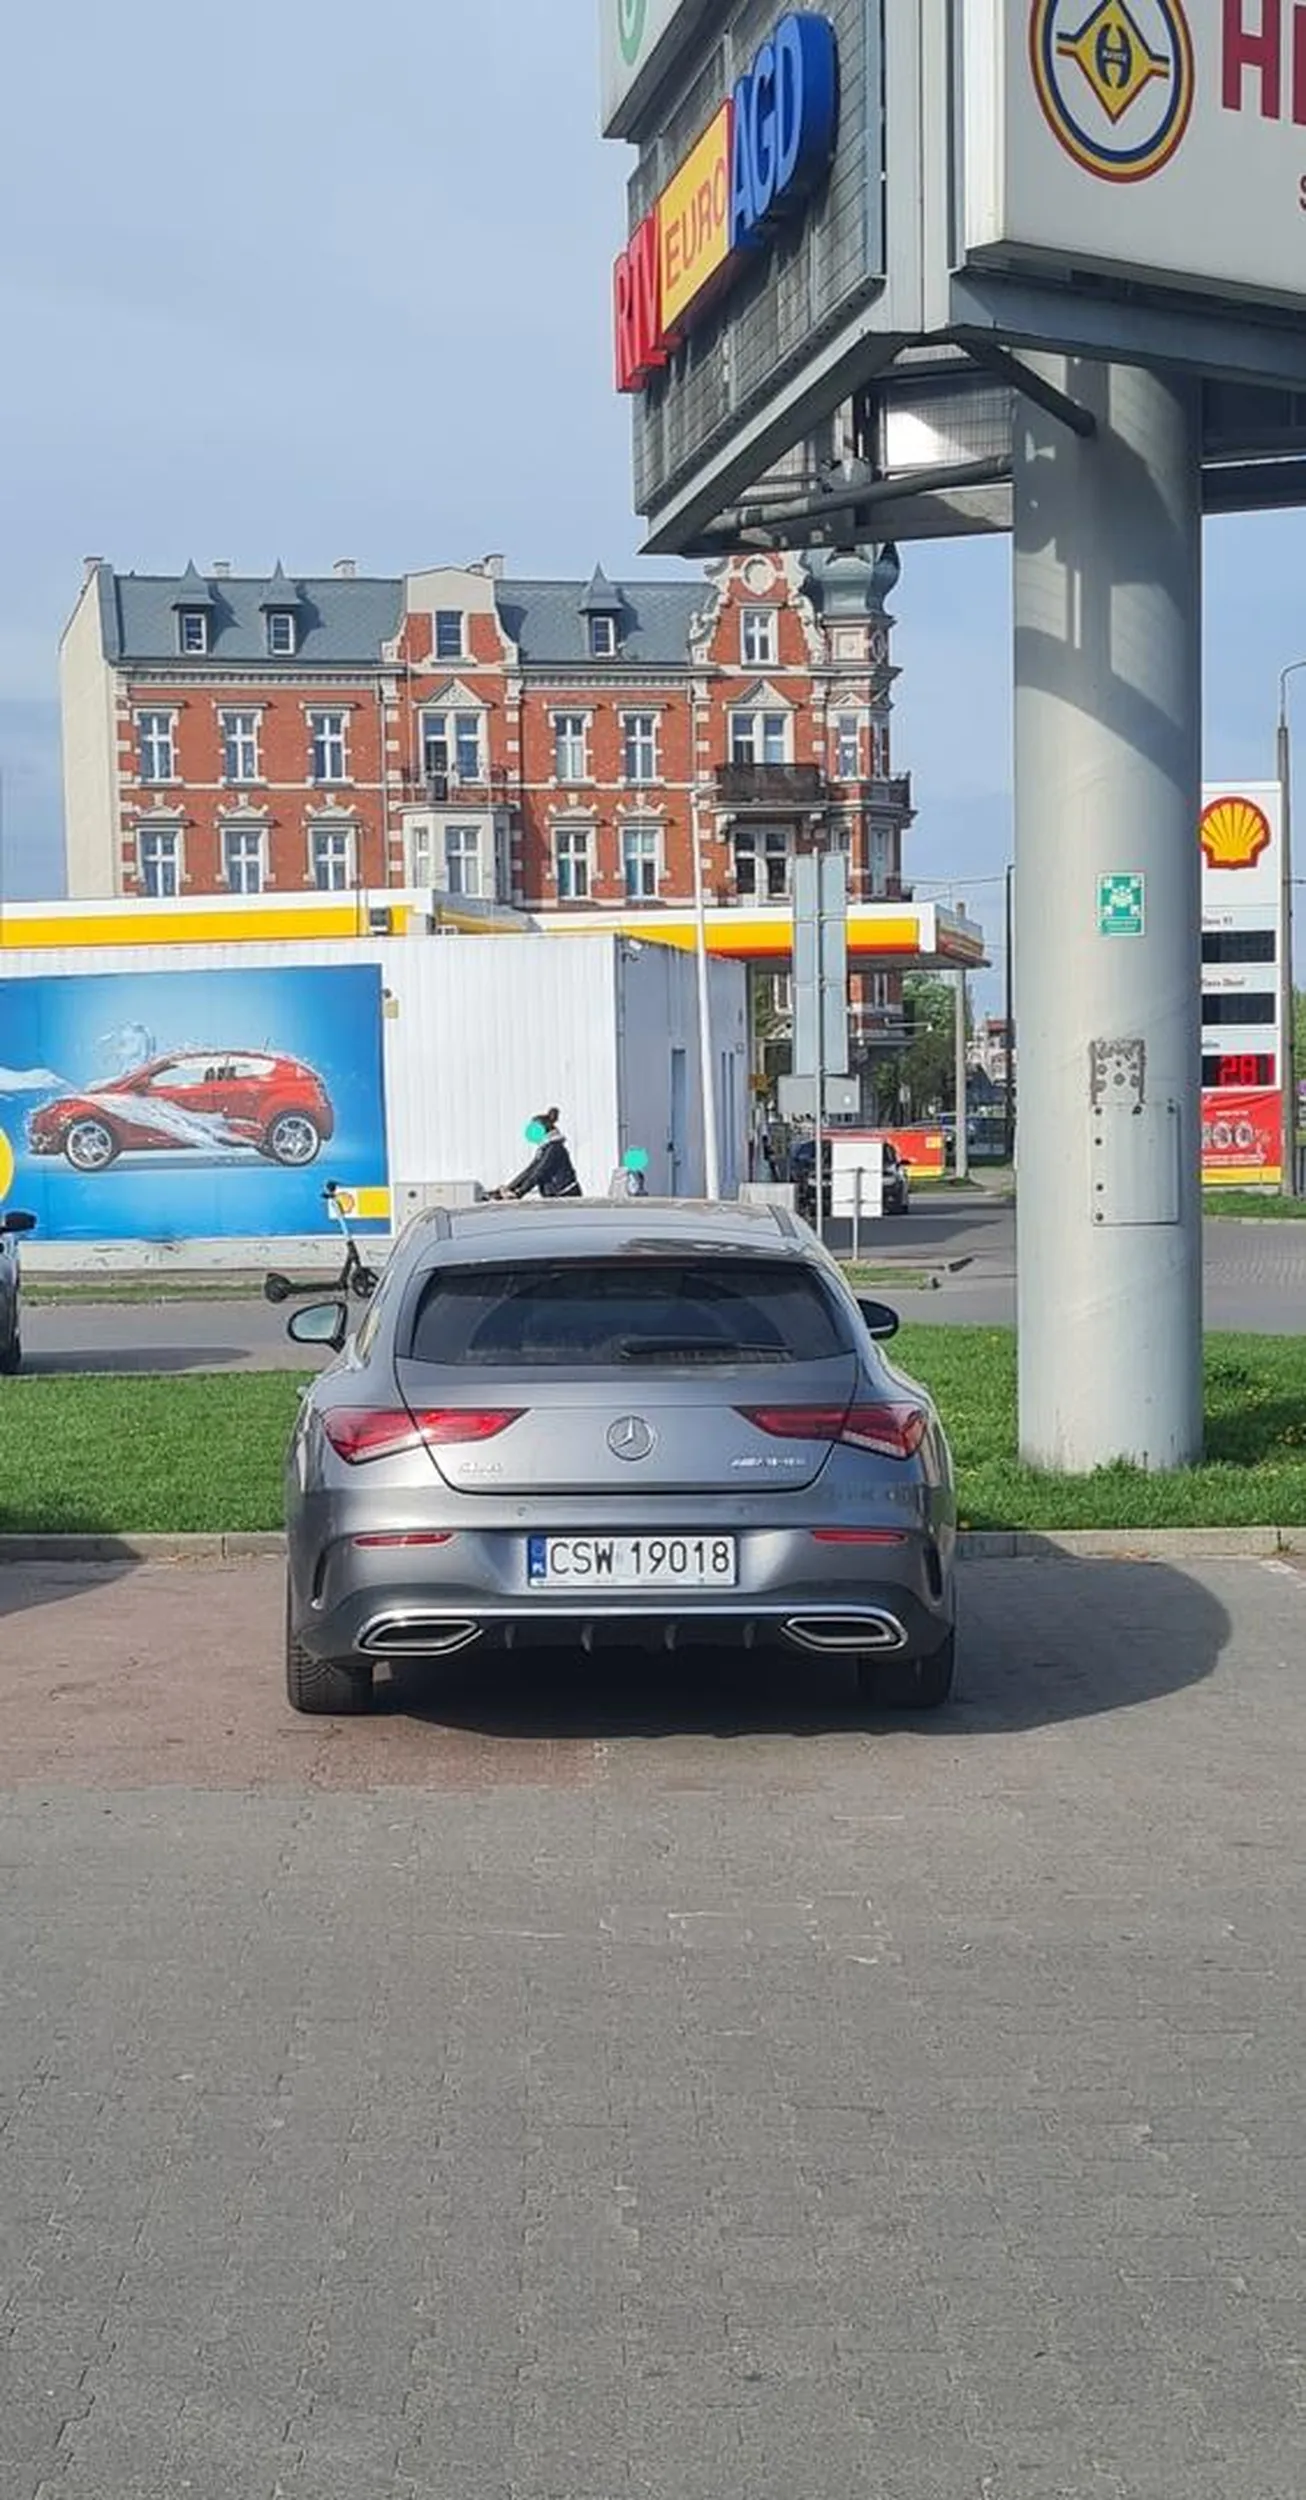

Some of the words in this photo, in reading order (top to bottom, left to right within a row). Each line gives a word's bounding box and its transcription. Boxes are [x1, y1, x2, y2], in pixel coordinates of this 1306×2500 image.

[614, 210, 662, 392] RTV
[664, 156, 728, 292] EURO
[731, 12, 805, 250] AGD
[551, 1540, 615, 1575] CSW
[631, 1540, 730, 1575] 19018
